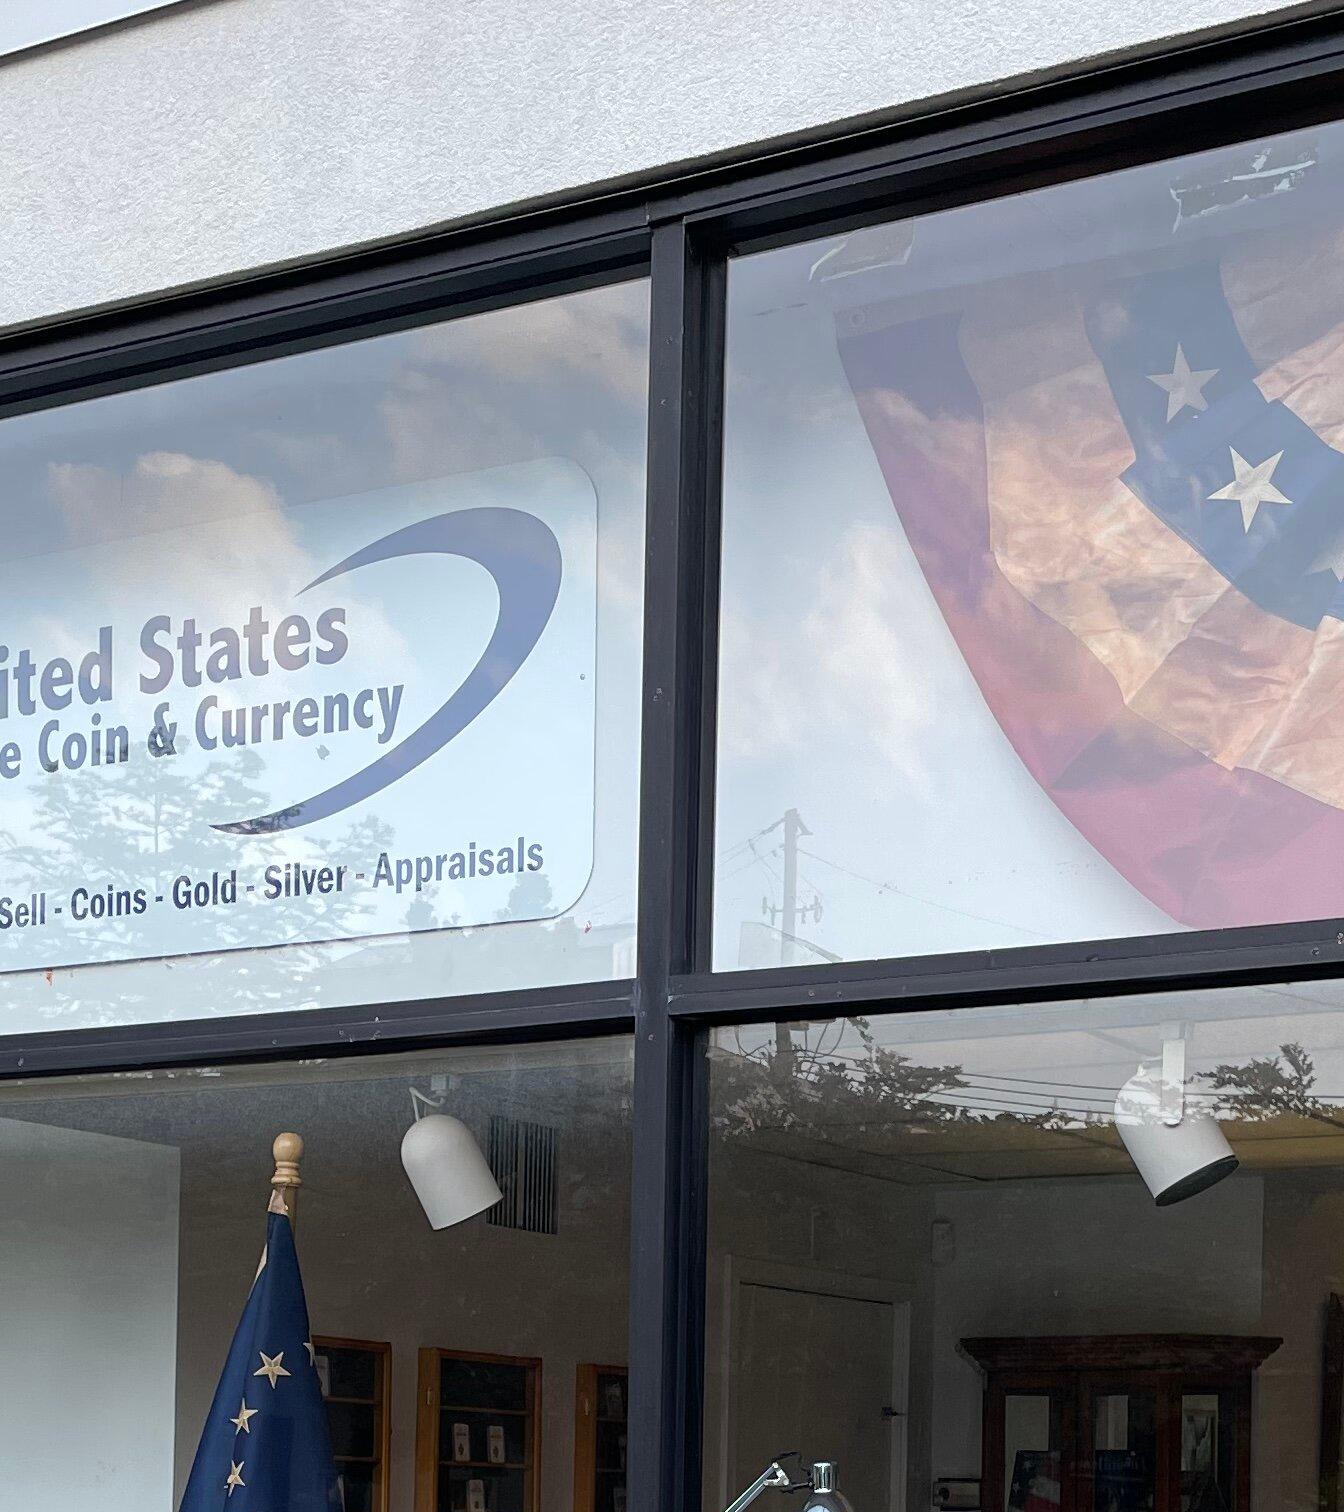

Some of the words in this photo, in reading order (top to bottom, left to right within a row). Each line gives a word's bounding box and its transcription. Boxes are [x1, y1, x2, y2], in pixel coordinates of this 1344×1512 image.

[139, 607, 349, 695] States
[38, 713, 129, 774] Coin
[147, 701, 178, 759] &
[195, 684, 405, 752] Currency
[70, 883, 148, 921] Coins
[172, 870, 237, 910] Gold
[263, 862, 348, 900] Silver
[372, 836, 545, 894] Appraisals
